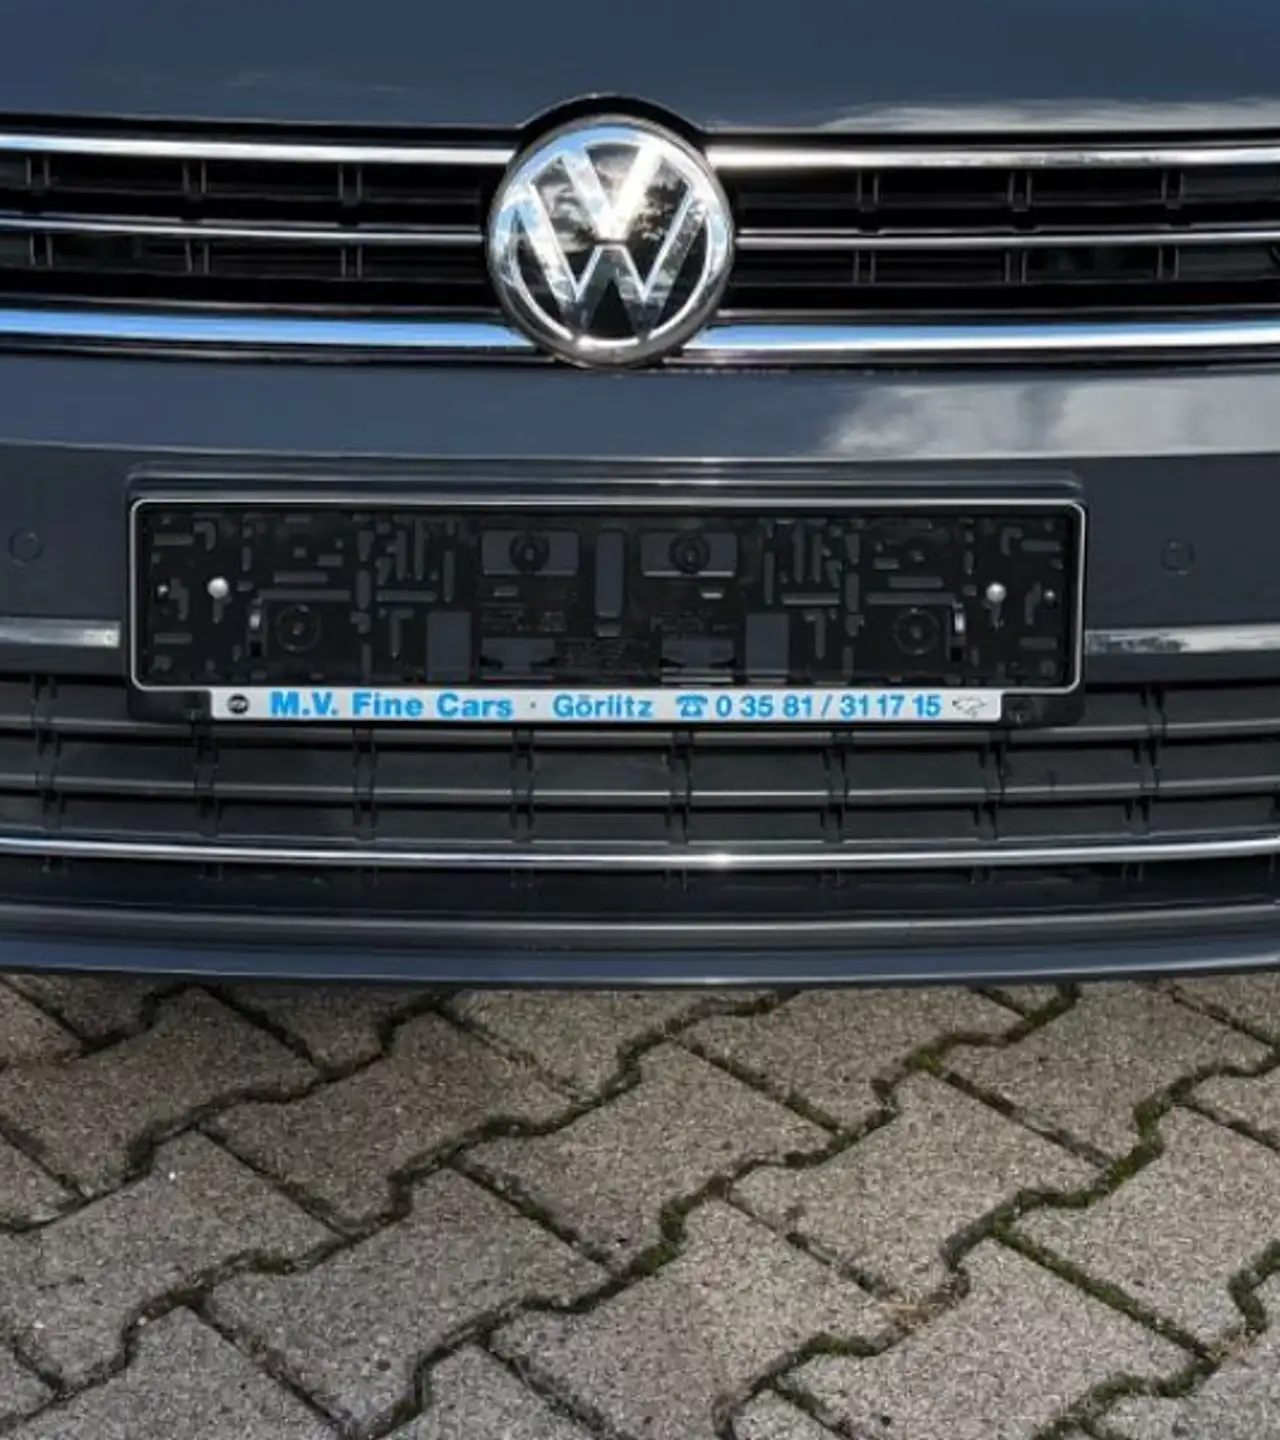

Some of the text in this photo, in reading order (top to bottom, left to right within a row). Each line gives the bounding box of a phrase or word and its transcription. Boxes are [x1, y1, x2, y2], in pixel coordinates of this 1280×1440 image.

[510, 132, 715, 348] VW
[270, 691, 337, 716] M.V.
[352, 692, 424, 717] Fine
[436, 692, 513, 718] Cars
[553, 693, 653, 718] Görlitz
